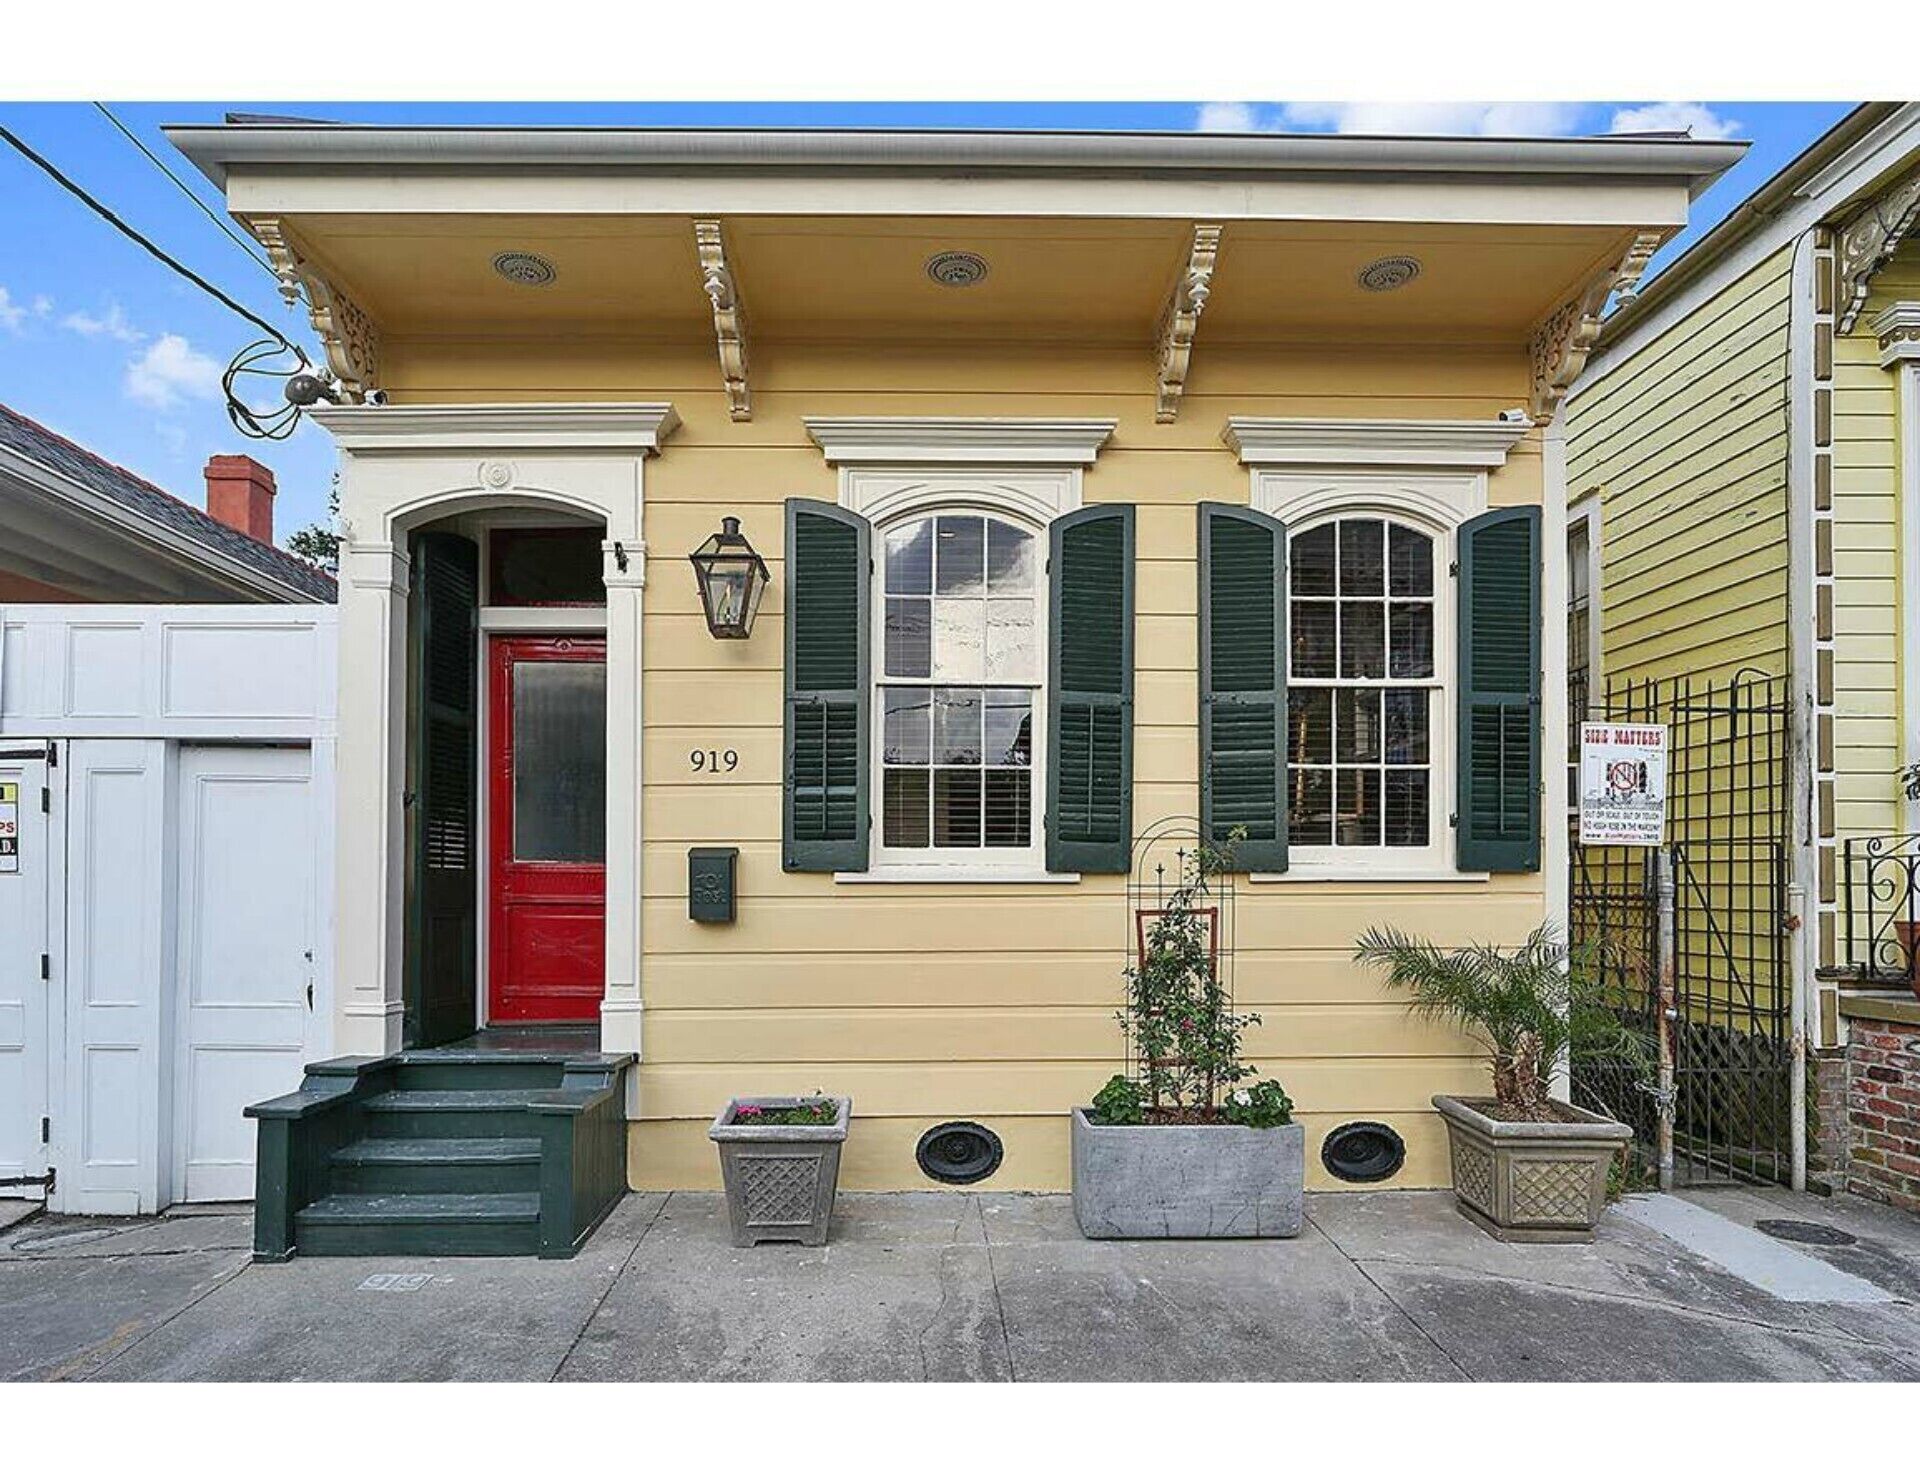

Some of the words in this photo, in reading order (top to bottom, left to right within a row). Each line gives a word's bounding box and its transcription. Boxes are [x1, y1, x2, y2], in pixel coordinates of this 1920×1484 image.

[1585, 729, 1608, 744] SIZE
[1615, 730, 1661, 746] MATTERS
[690, 750, 738, 773] 919
